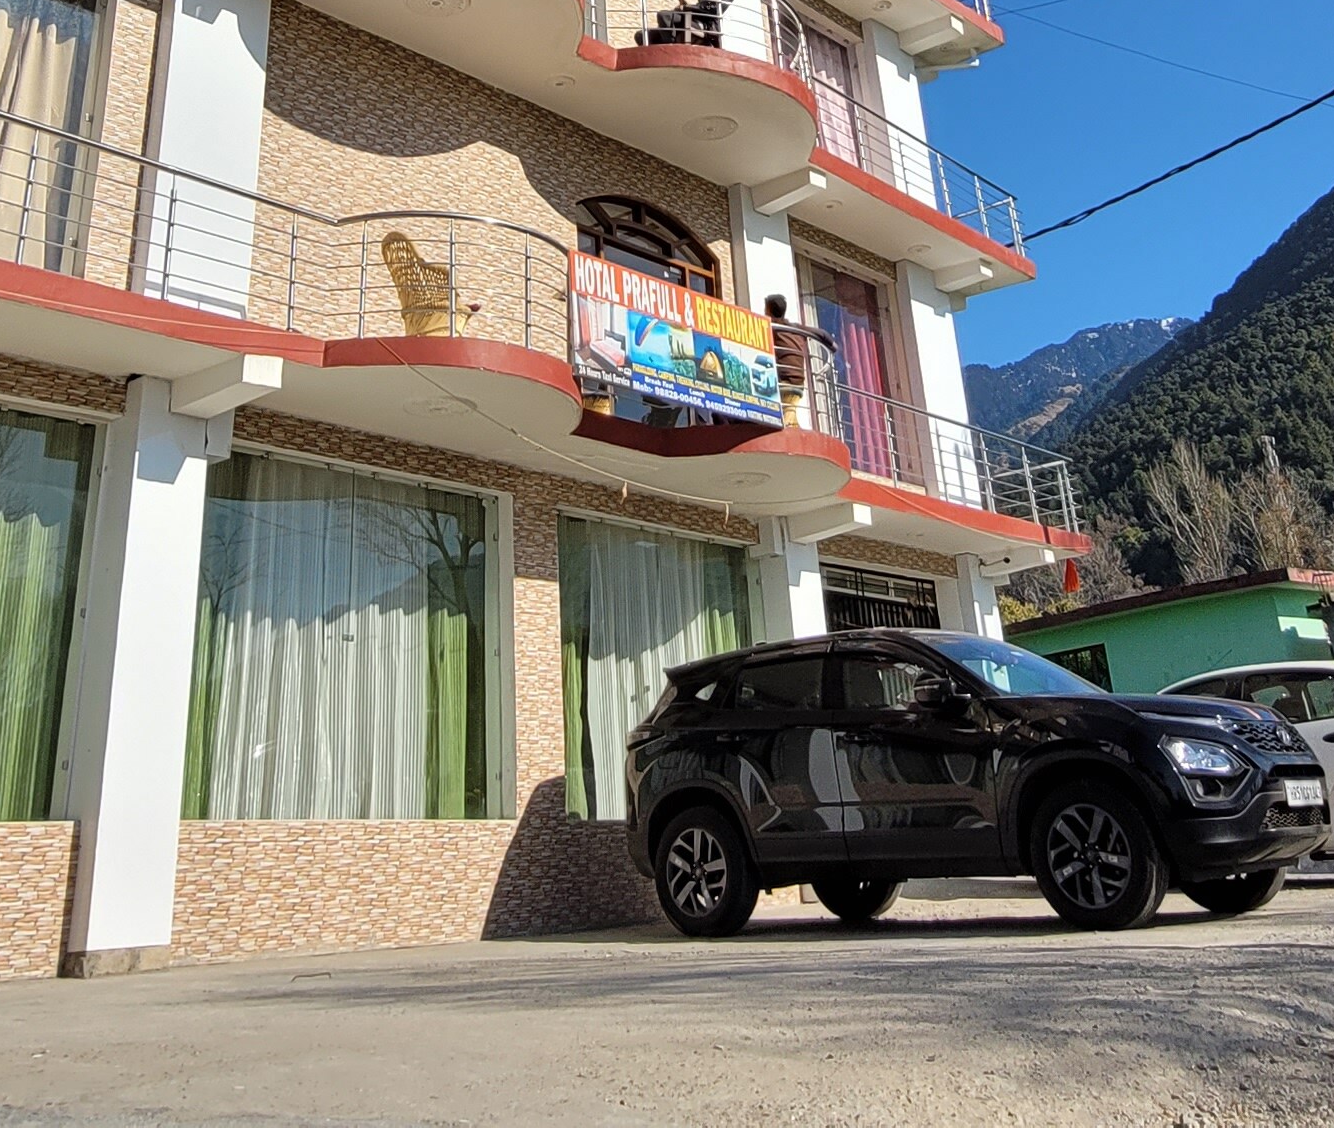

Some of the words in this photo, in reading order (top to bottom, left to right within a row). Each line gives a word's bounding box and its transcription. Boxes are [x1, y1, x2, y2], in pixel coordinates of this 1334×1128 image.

[574, 254, 619, 302] HOTAL
[622, 270, 681, 322] PRAFULL
[684, 292, 695, 327] &
[696, 296, 769, 352] RESTAURANT
[613, 373, 630, 386] Service
[724, 398, 741, 408] Dinner
